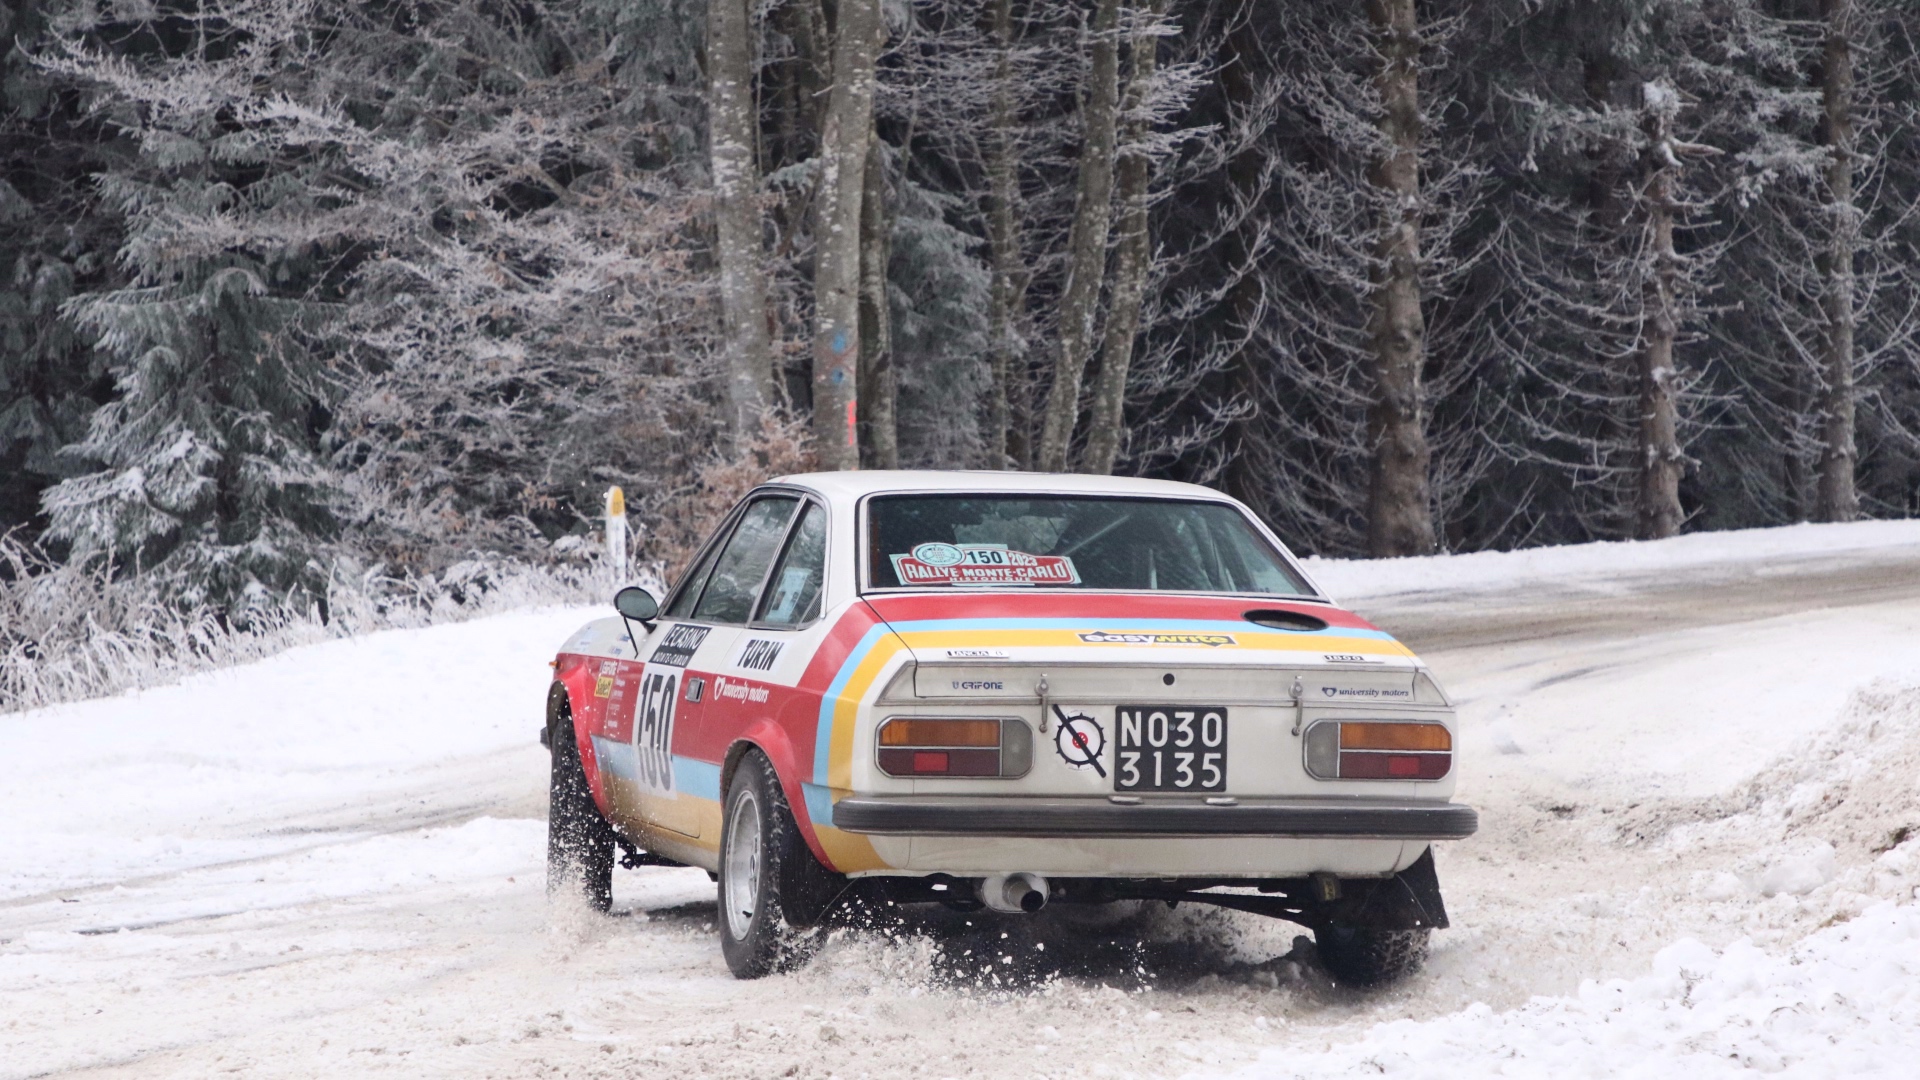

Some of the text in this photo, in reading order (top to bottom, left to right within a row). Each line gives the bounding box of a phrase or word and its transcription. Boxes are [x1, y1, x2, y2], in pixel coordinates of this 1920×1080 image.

[905, 562, 1067, 579] RALLYE MONTE-CARLO
[966, 551, 1003, 564] 150
[1008, 552, 1038, 566] 2023
[670, 626, 708, 650] CASINO
[1085, 634, 1229, 644] easywrite
[737, 639, 785, 671] TURIN
[722, 679, 770, 704] university motors
[1339, 687, 1409, 698] university motors
[637, 673, 676, 792] 150
[1119, 751, 1222, 788] 3135
